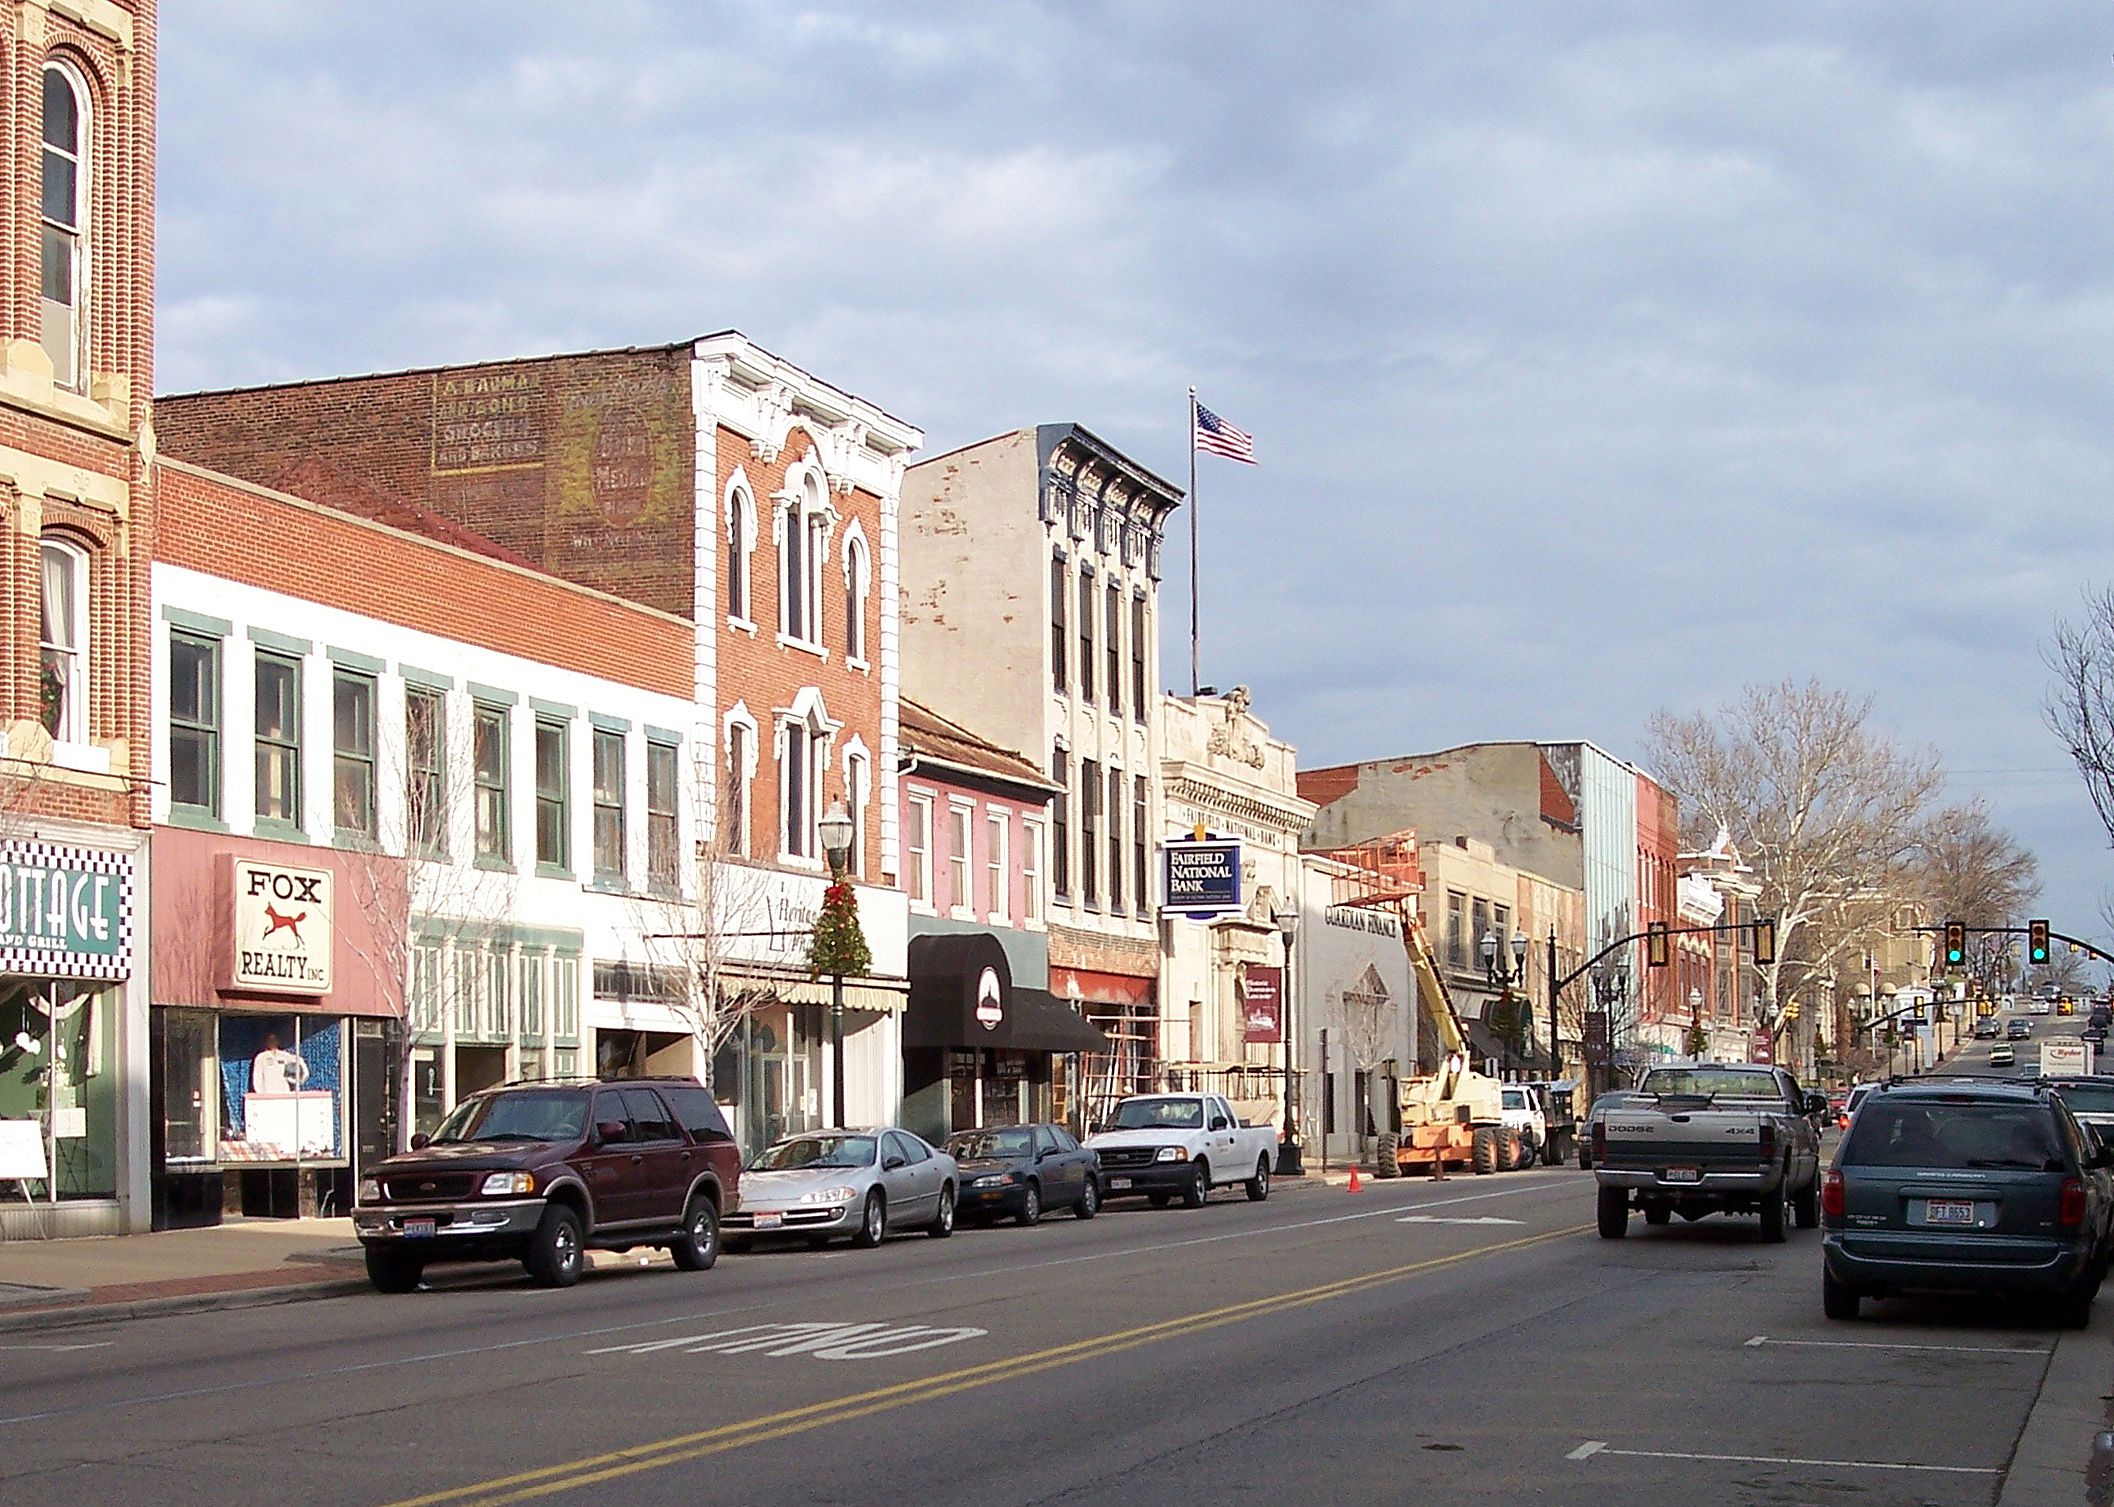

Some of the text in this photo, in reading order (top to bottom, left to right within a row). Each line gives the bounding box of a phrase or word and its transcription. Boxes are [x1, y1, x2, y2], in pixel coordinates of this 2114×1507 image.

[1171, 852, 1225, 865] FAIRFIELD
[1171, 865, 1232, 879] NATIONAL
[247, 870, 322, 904] FOX
[1171, 879, 1204, 892] BANK
[1325, 905, 1366, 931] GUARDIAN
[27, 935, 68, 951] GRILL
[241, 950, 324, 981] REALTY INC
[1608, 1124, 1655, 1133] DODGE
